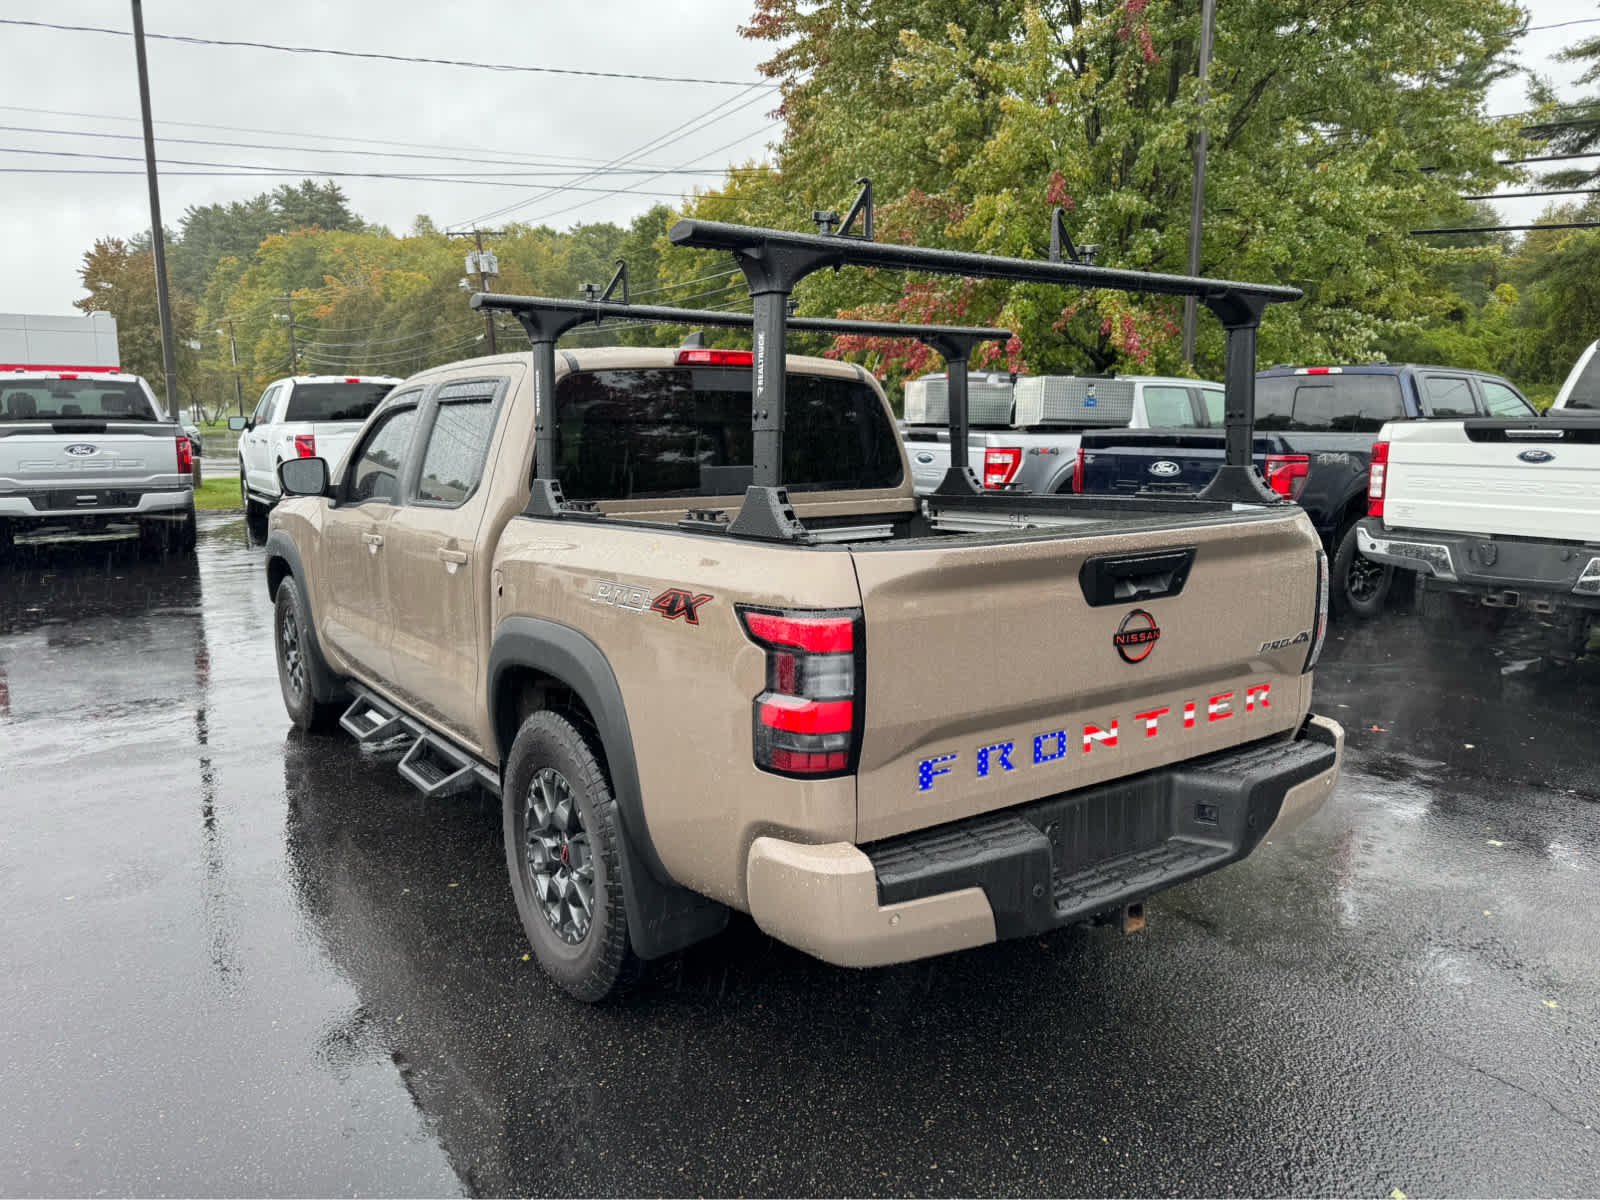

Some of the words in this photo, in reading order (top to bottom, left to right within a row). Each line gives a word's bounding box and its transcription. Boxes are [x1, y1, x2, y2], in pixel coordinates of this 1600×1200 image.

[70, 445, 96, 455] Ford
[1116, 631, 1160, 644] NISSAN
[919, 683, 1271, 791] FRONTIER
